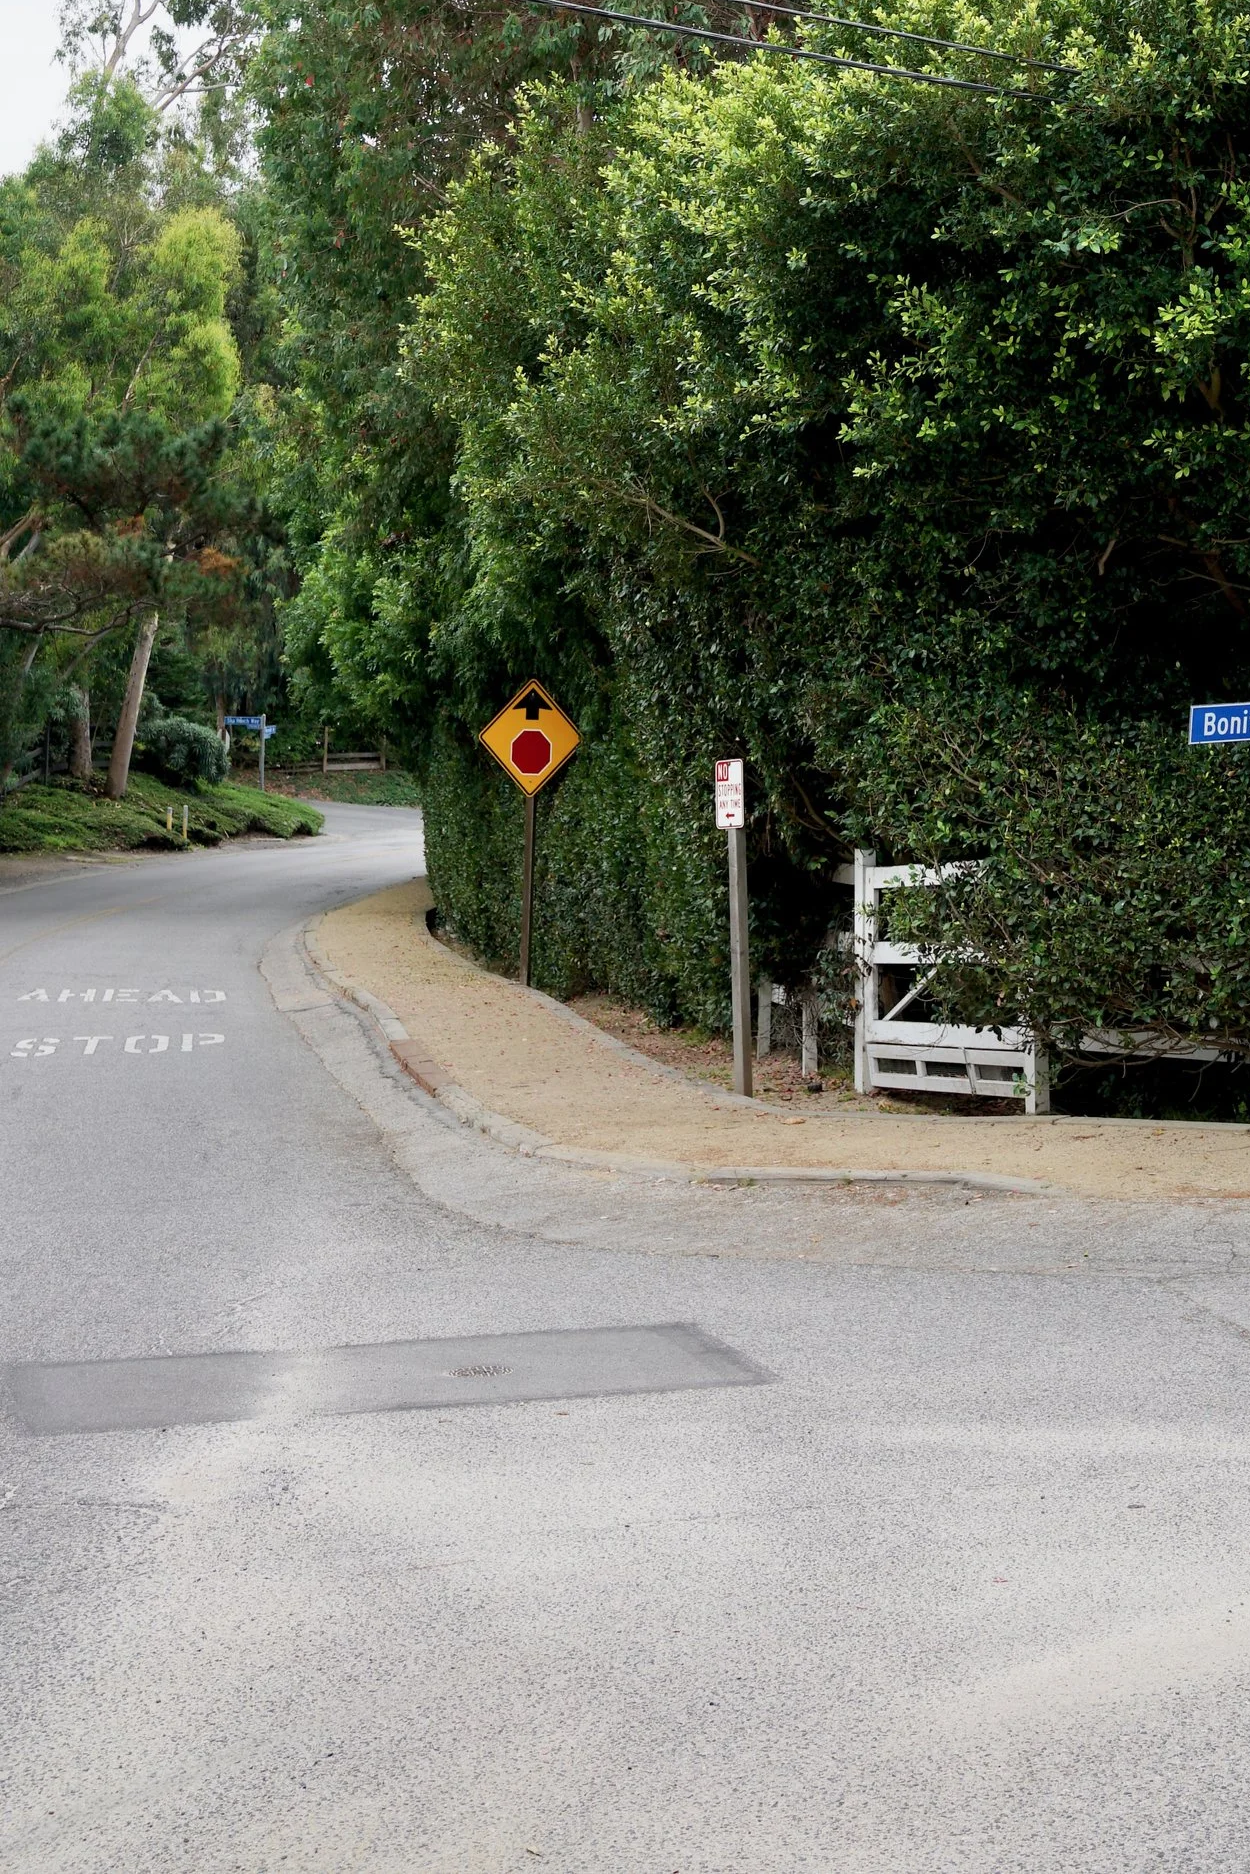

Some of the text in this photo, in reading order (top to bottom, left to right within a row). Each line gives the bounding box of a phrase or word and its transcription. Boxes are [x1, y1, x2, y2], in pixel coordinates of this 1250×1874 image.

[717, 764, 728, 780] NO
[718, 784, 741, 797] STOPPING
[16, 987, 227, 1004] AHEAD
[9, 1032, 226, 1058] STOP
